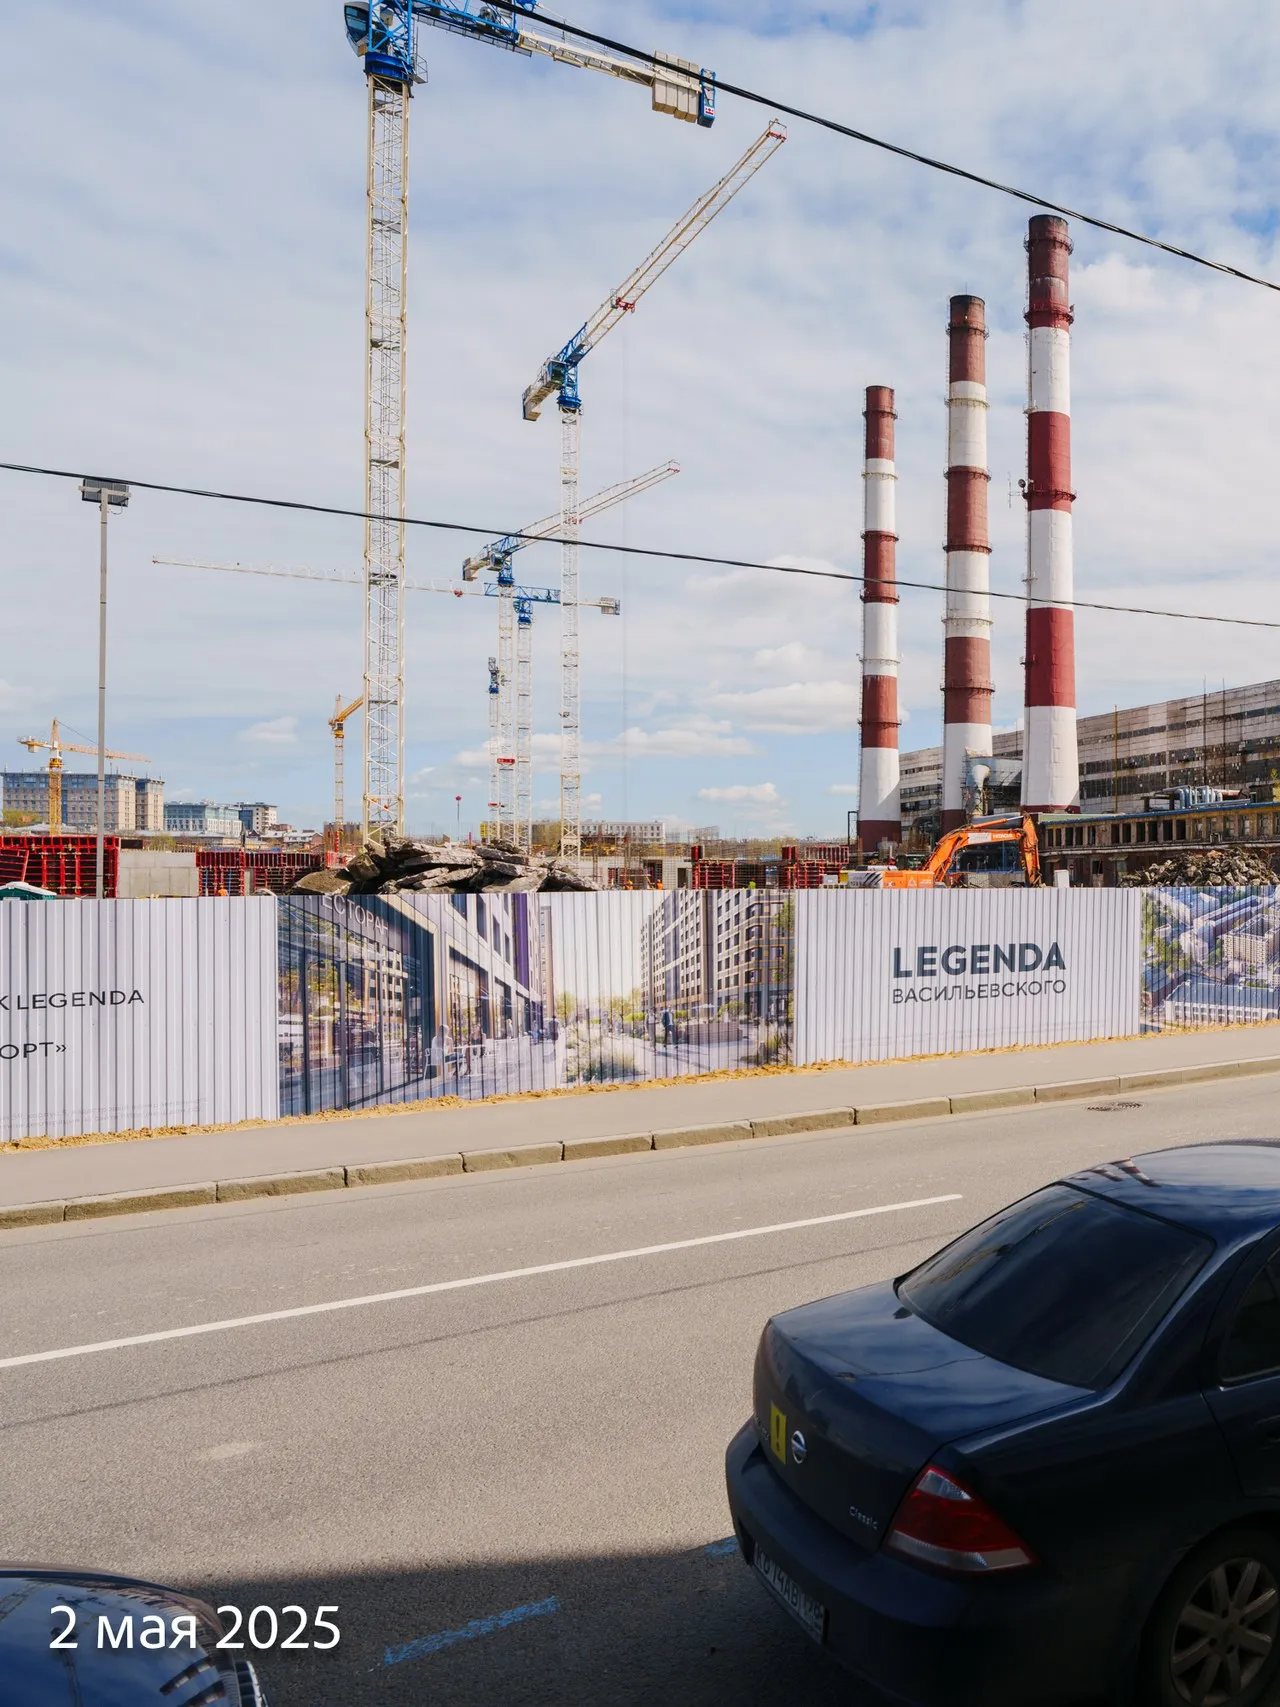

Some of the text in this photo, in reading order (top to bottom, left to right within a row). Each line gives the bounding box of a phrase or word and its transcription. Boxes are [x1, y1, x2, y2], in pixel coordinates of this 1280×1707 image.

[893, 941, 1067, 978] LEGENDA
[17, 989, 145, 1010] LEGENDA
[892, 979, 1067, 1004] ВАСИЛЬЕВСКОГО
